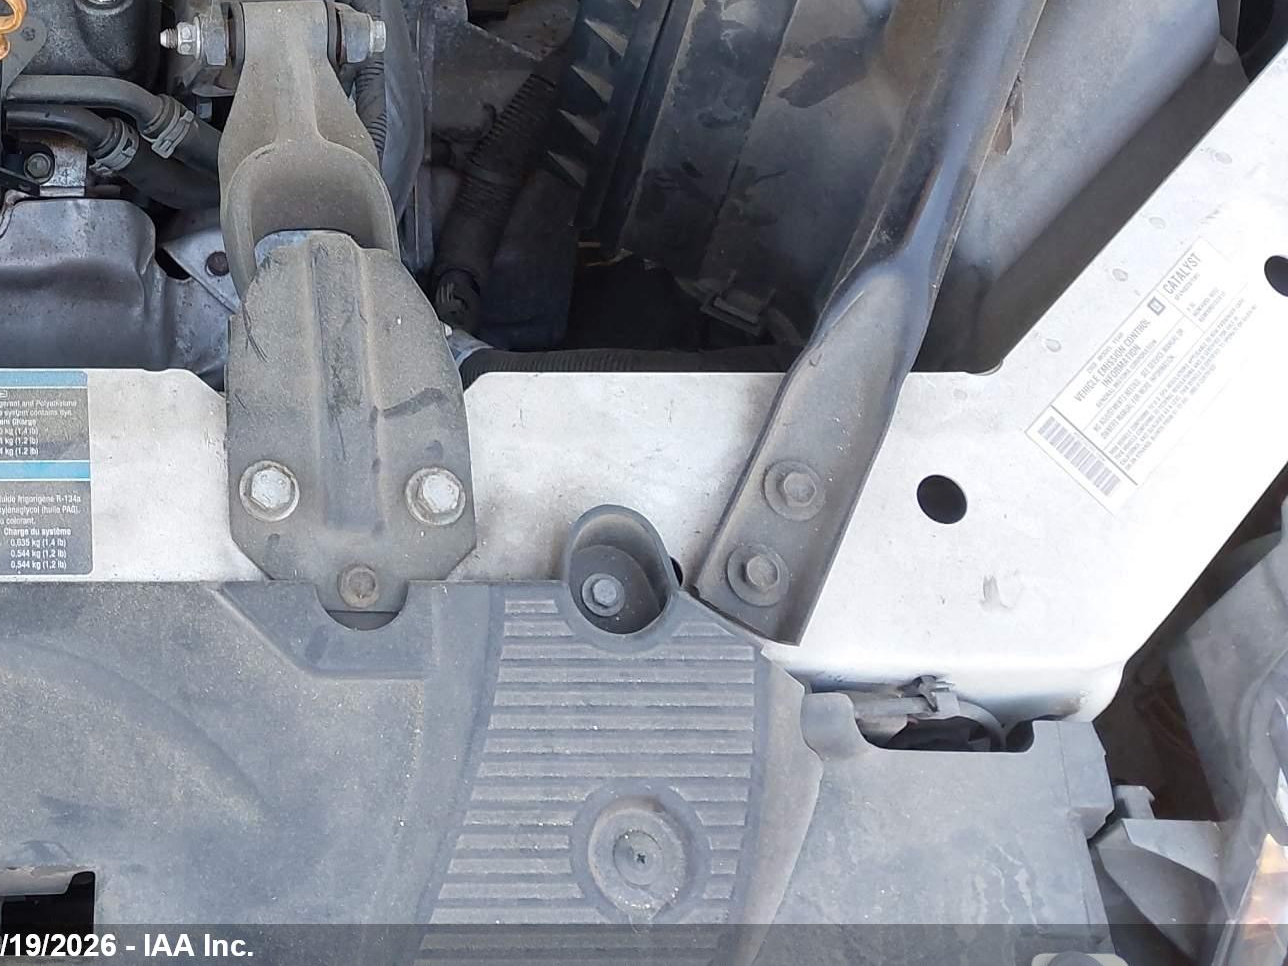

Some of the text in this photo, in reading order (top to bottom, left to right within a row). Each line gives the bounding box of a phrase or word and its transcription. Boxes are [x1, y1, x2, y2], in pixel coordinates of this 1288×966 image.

[1162, 252, 1201, 294] CATALYST
[1074, 374, 1100, 401] VEHICLE
[1097, 345, 1125, 375] EMISSION
[1123, 318, 1149, 346] CONTROL
[1101, 344, 1140, 386] INFORMATION
[4, 437, 14, 446] kg
[14, 437, 29, 446] (1.2
[29, 437, 39, 446] lb)
[4, 447, 14, 457] kg
[14, 447, 29, 457] (1.2
[29, 447, 39, 457] lb)
[55, 494, 81, 503] R-134a
[3, 528, 29, 538] Charge
[30, 528, 40, 536] du
[31, 538, 41, 549] kg
[57, 538, 67, 548] lb)
[31, 549, 41, 559] kg
[57, 549, 67, 559] lb)
[31, 560, 41, 571] kg
[57, 560, 67, 570] lb)
